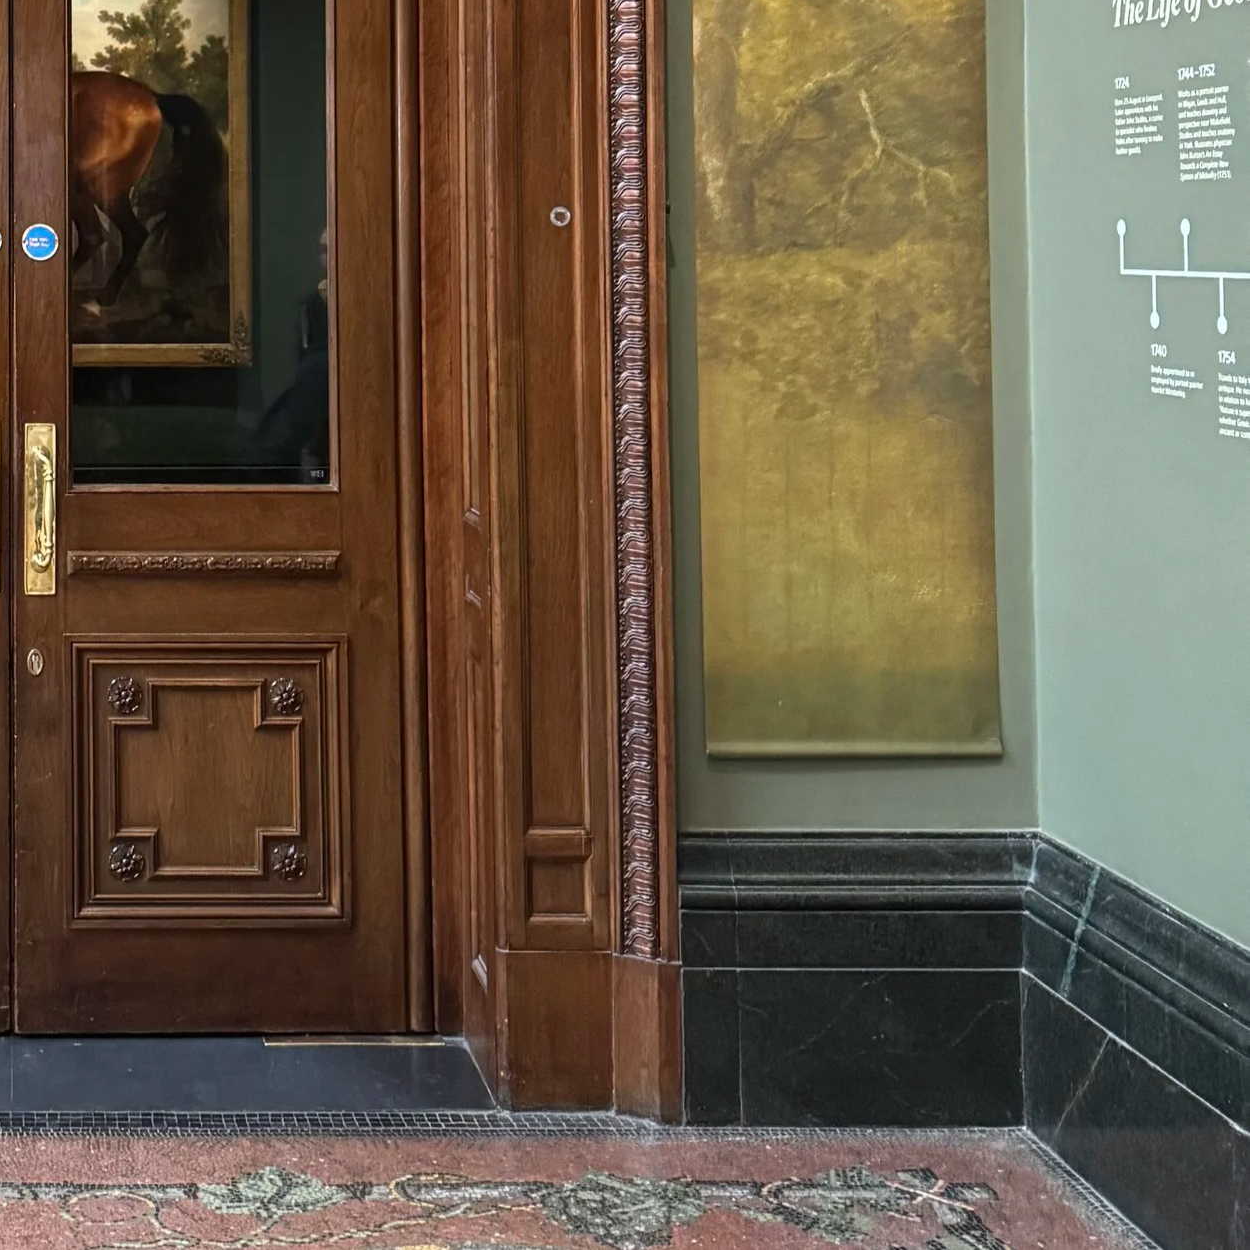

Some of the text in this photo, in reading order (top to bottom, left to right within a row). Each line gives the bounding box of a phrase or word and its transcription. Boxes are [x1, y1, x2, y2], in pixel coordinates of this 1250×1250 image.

[1114, 76, 1130, 90] 1724
[1150, 343, 1168, 358] 1740
[1217, 350, 1236, 365] 1754
